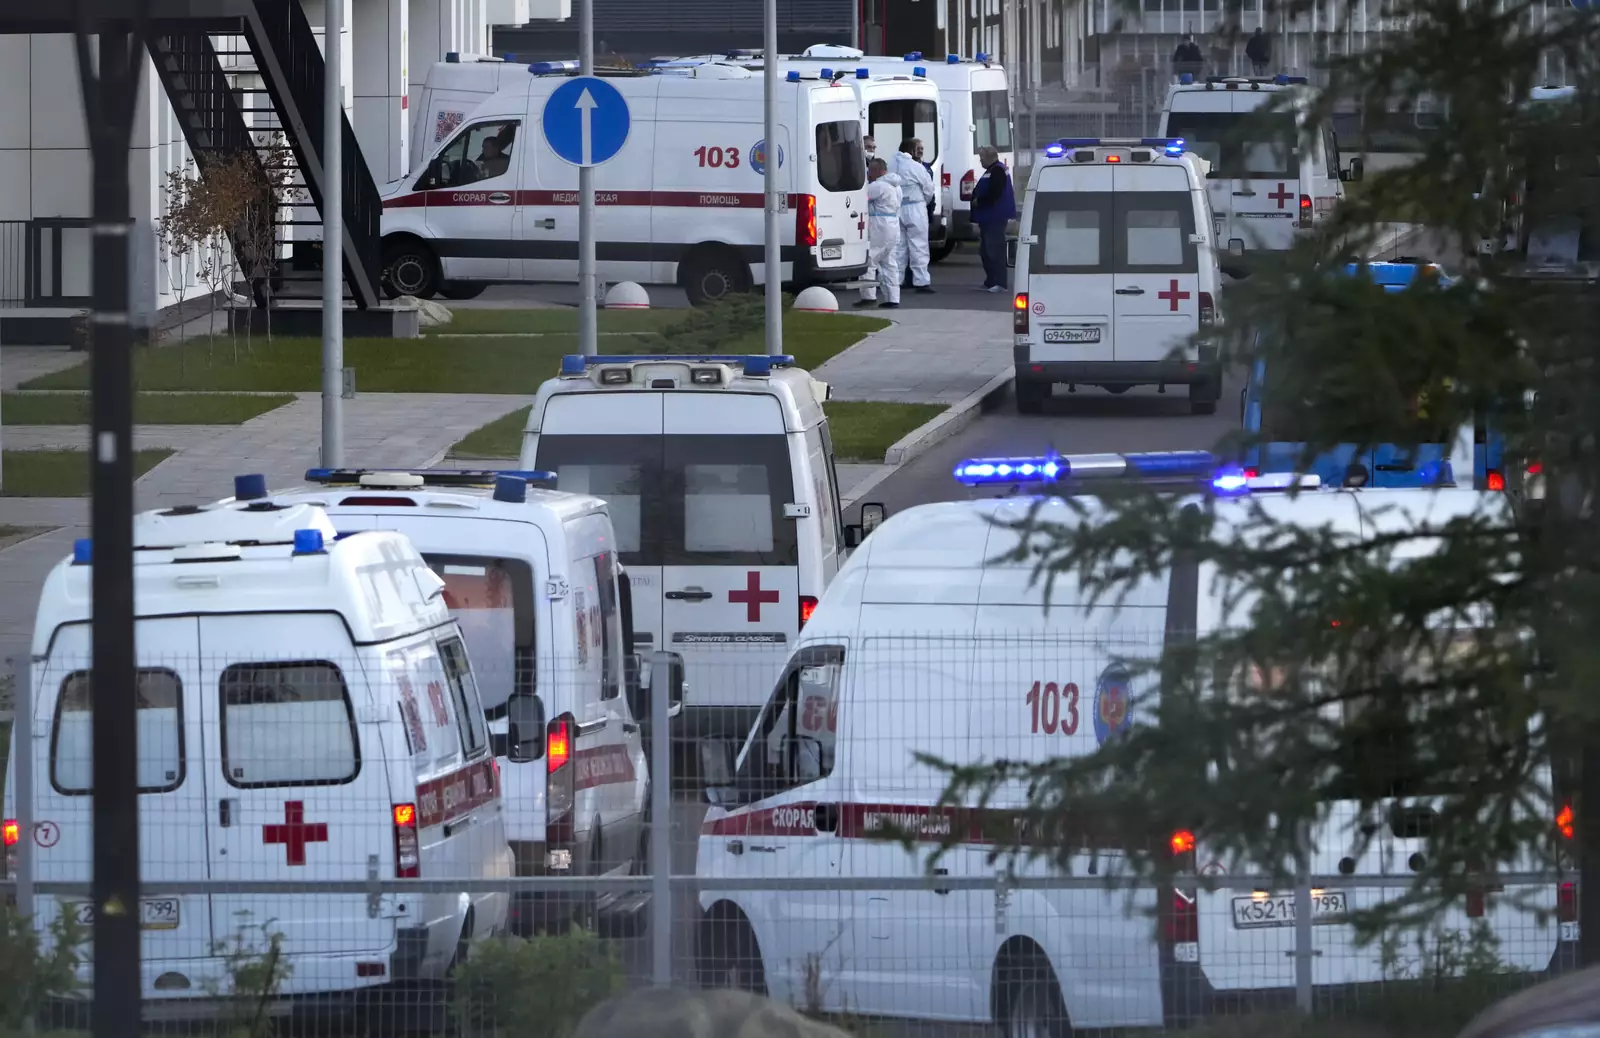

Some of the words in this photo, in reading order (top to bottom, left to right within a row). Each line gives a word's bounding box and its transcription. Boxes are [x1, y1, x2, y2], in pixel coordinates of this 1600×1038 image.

[693, 145, 740, 169] 103
[452, 193, 486, 202] СКОРАЯ
[552, 193, 618, 203] МЕДИСКАЯ
[700, 195, 740, 205] ПОМОЩЬ
[1026, 680, 1080, 736] 103
[772, 808, 815, 829] СКОРАЯ
[42, 828, 50, 840] 7
